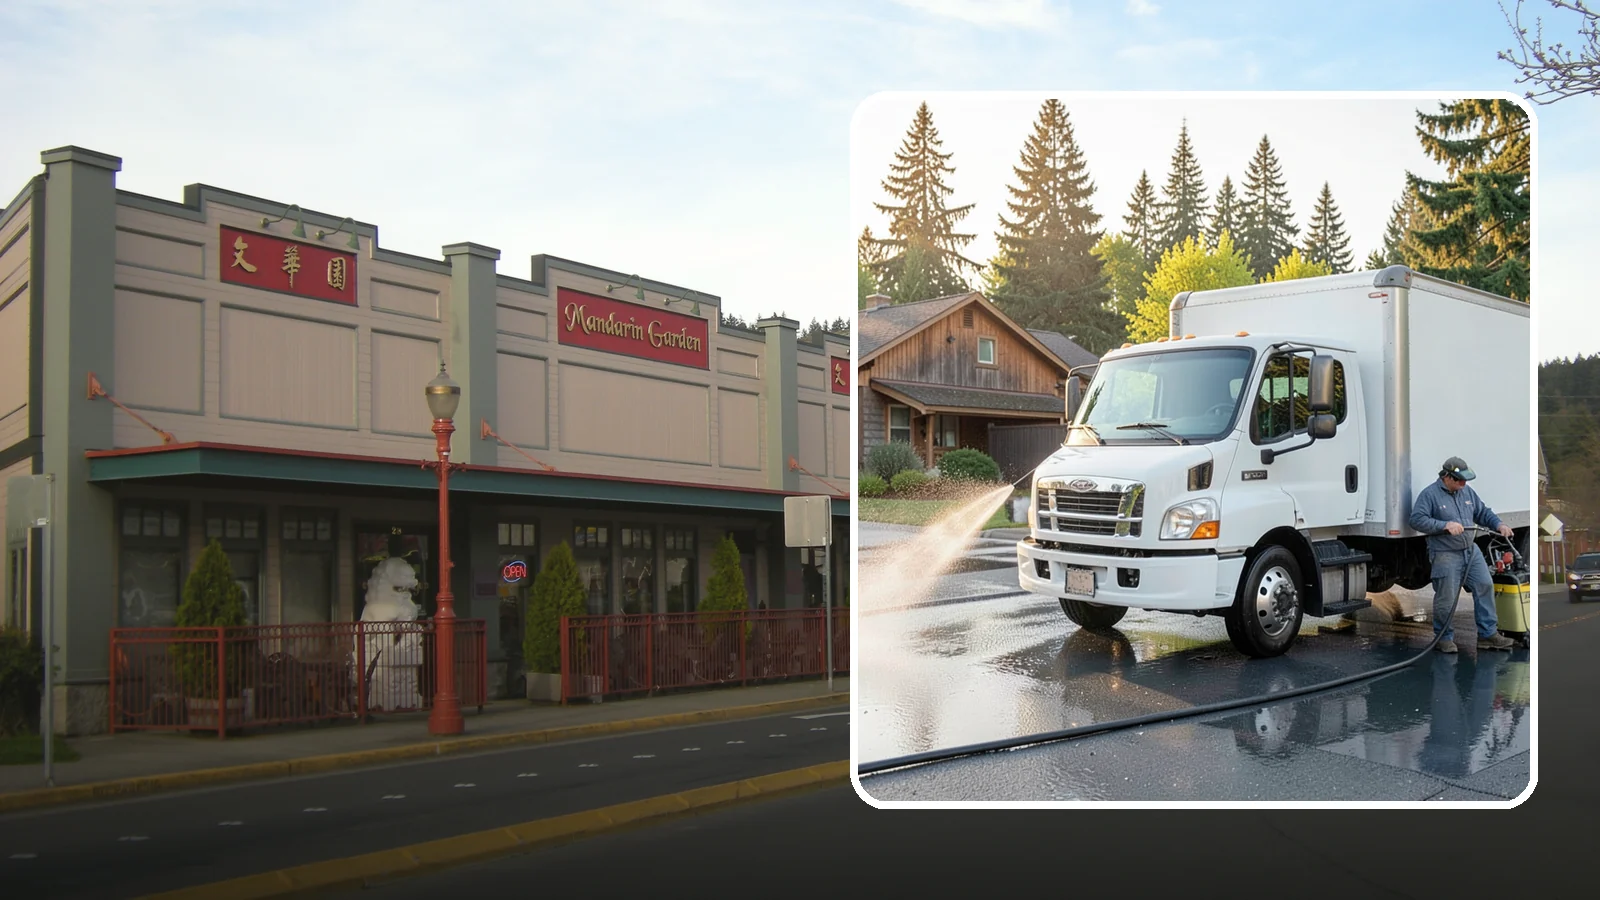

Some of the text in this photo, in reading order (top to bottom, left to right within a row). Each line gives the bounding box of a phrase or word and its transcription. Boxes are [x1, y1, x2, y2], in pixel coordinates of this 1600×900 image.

[231, 235, 346, 291] 文華園
[564, 302, 702, 352] Mandarin Garden
[503, 565, 527, 578] OPEN
